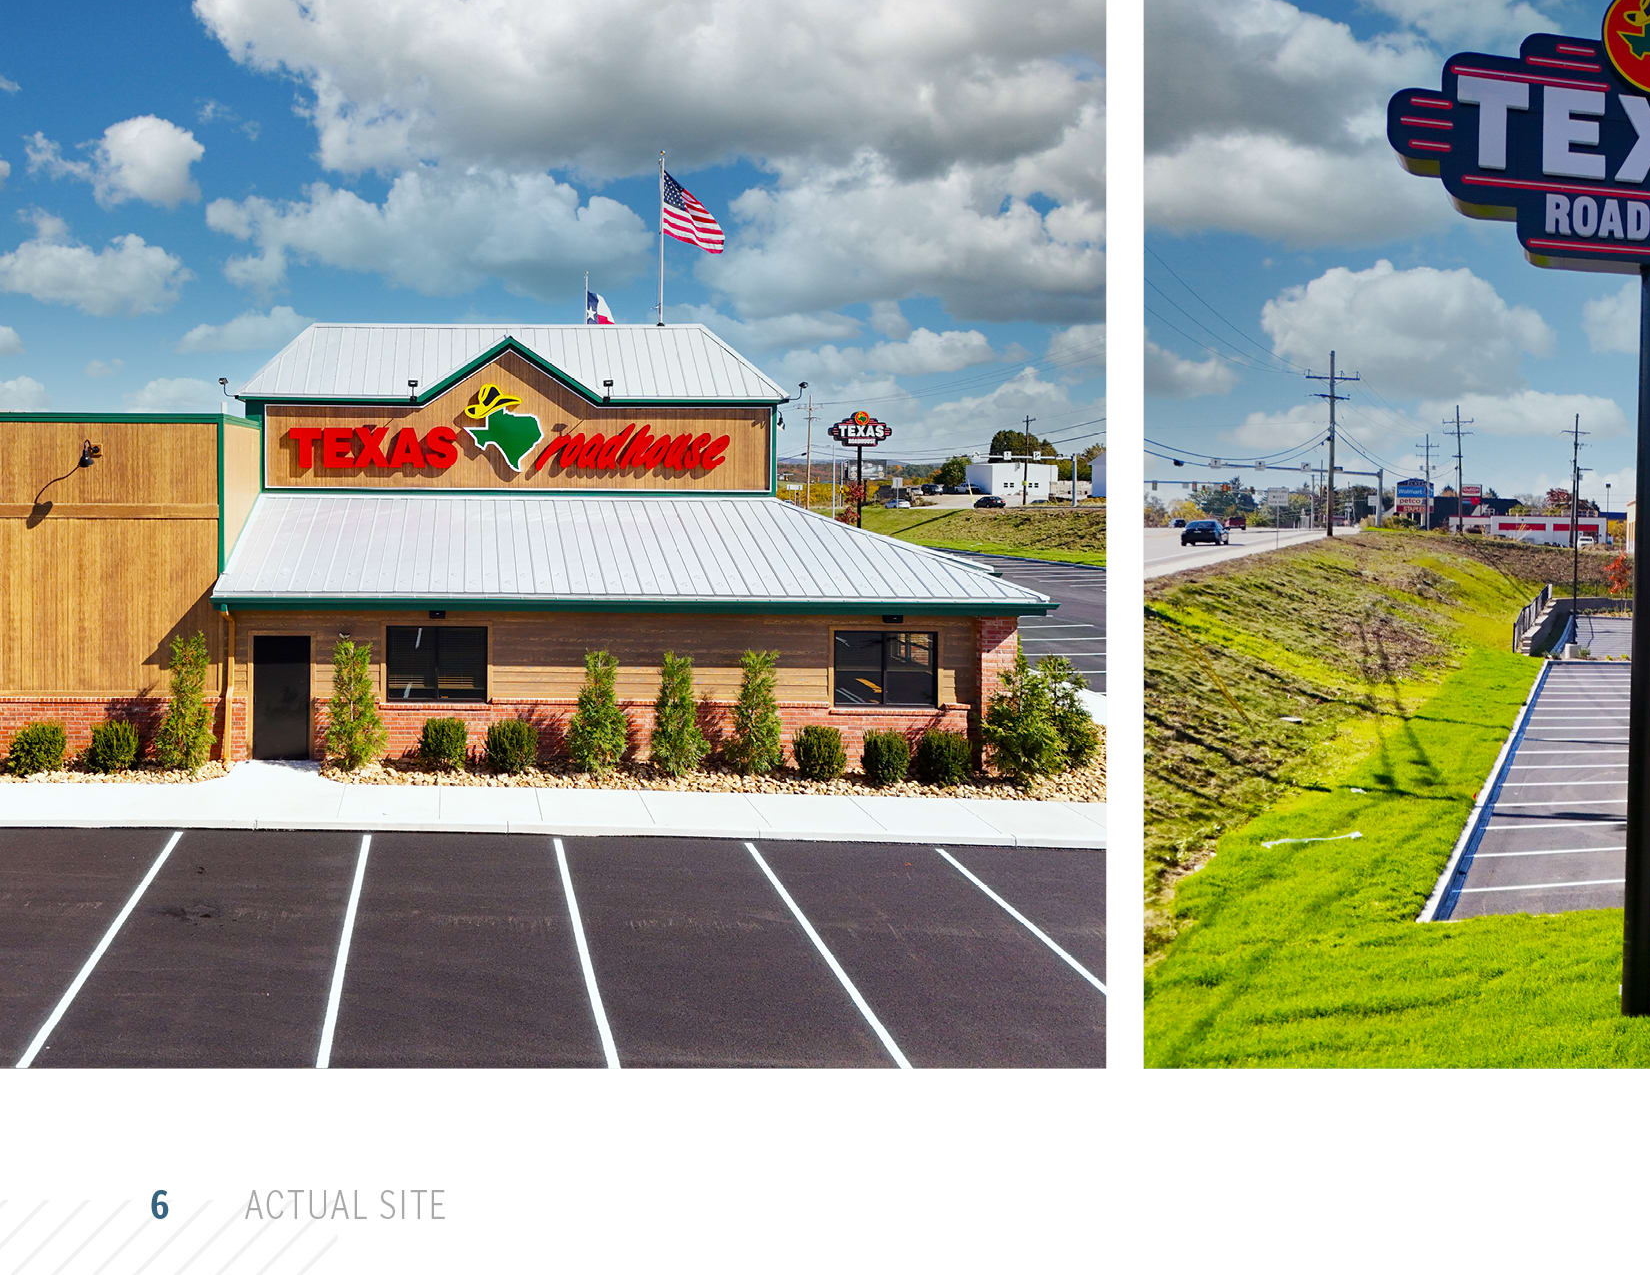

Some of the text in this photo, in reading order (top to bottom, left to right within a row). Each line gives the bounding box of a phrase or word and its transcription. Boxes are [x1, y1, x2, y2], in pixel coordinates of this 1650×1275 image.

[288, 422, 732, 472] TEXAS roadhouse
[838, 425, 885, 438] TEXAS
